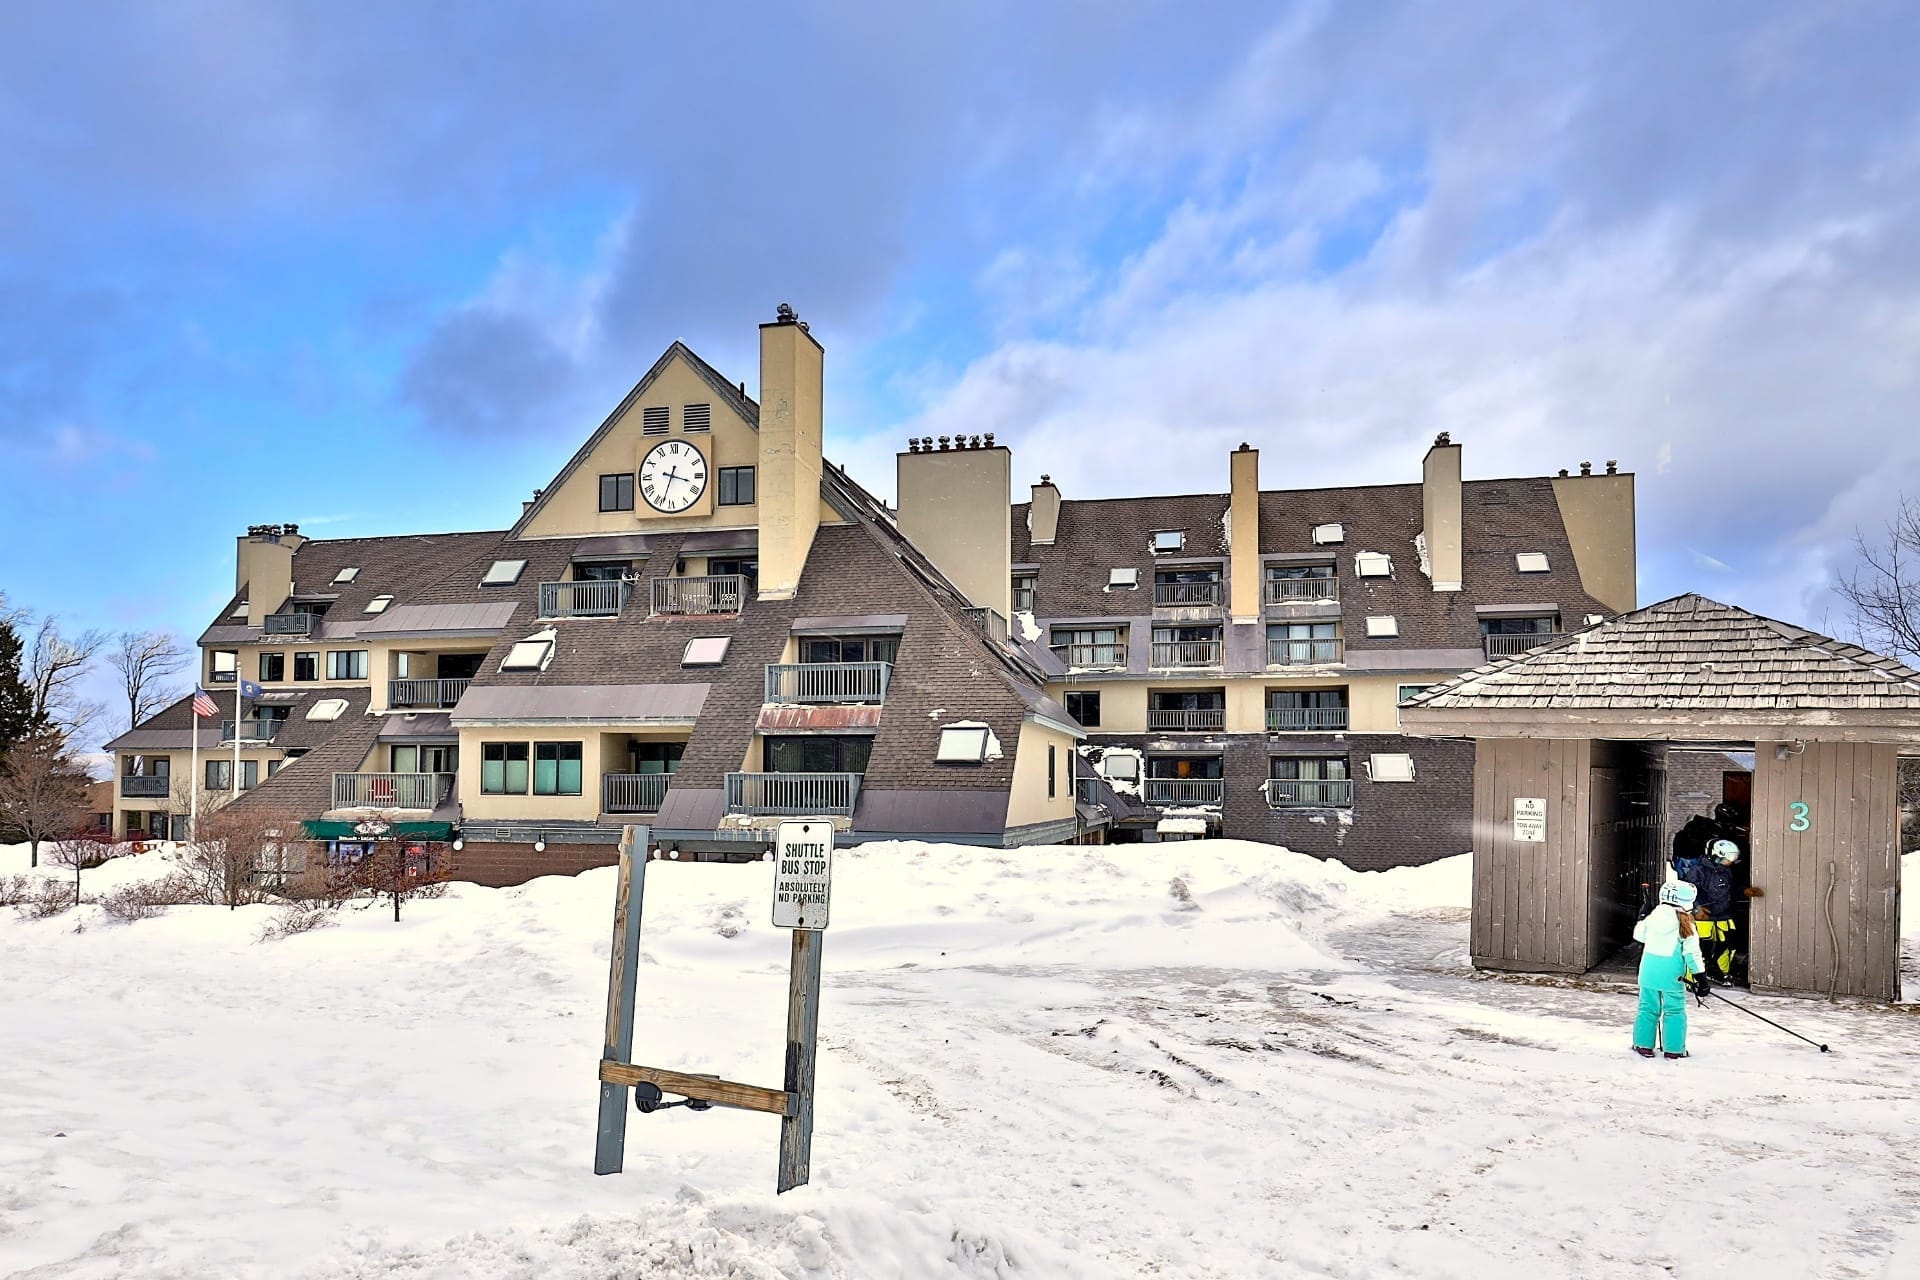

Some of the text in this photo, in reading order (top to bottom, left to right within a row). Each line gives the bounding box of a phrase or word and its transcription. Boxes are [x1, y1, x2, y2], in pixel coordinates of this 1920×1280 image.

[670, 443, 679, 454] XII
[1790, 801, 1811, 832] 3
[785, 843, 825, 858] SHUTTLE
[781, 860, 826, 875] BUS STOP
[778, 881, 826, 893] ABSOLUTELY
[778, 892, 826, 904] NO PARKING
